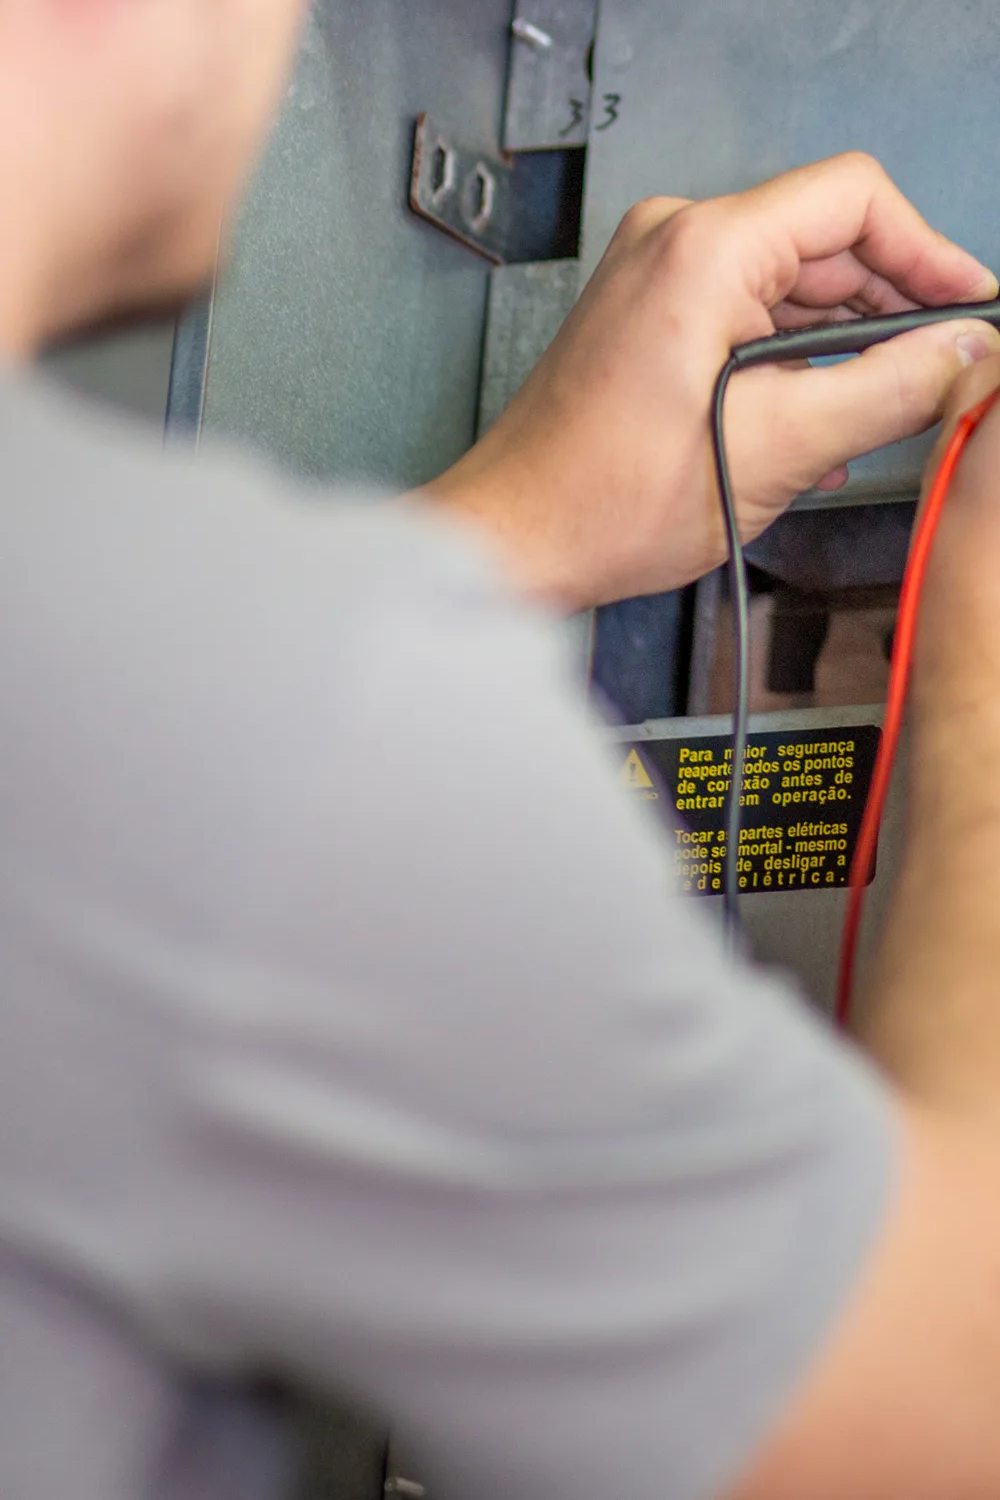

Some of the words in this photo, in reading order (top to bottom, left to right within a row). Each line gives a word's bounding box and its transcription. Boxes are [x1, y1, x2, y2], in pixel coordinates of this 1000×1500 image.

[595, 93, 621, 131] 3
[679, 747, 713, 763] Para
[777, 740, 855, 759] segurança
[783, 760, 801, 772] os
[804, 756, 854, 773] pontos
[677, 780, 696, 795] de
[781, 774, 823, 788] antes
[834, 770, 853, 785] de
[676, 794, 724, 810] entrar
[739, 793, 760, 807] em
[772, 786, 851, 807] operação.
[674, 829, 714, 845] Tocar
[717, 830, 729, 842] a
[739, 826, 783, 843] partes
[787, 821, 848, 837] elétricas
[738, 840, 783, 856] mortal
[795, 839, 847, 853] mesmo
[736, 858, 752, 873] de
[764, 854, 825, 872] desligar
[837, 854, 846, 866] a
[683, 875, 721, 891] ede
[738, 871, 845, 888] elétrica.
